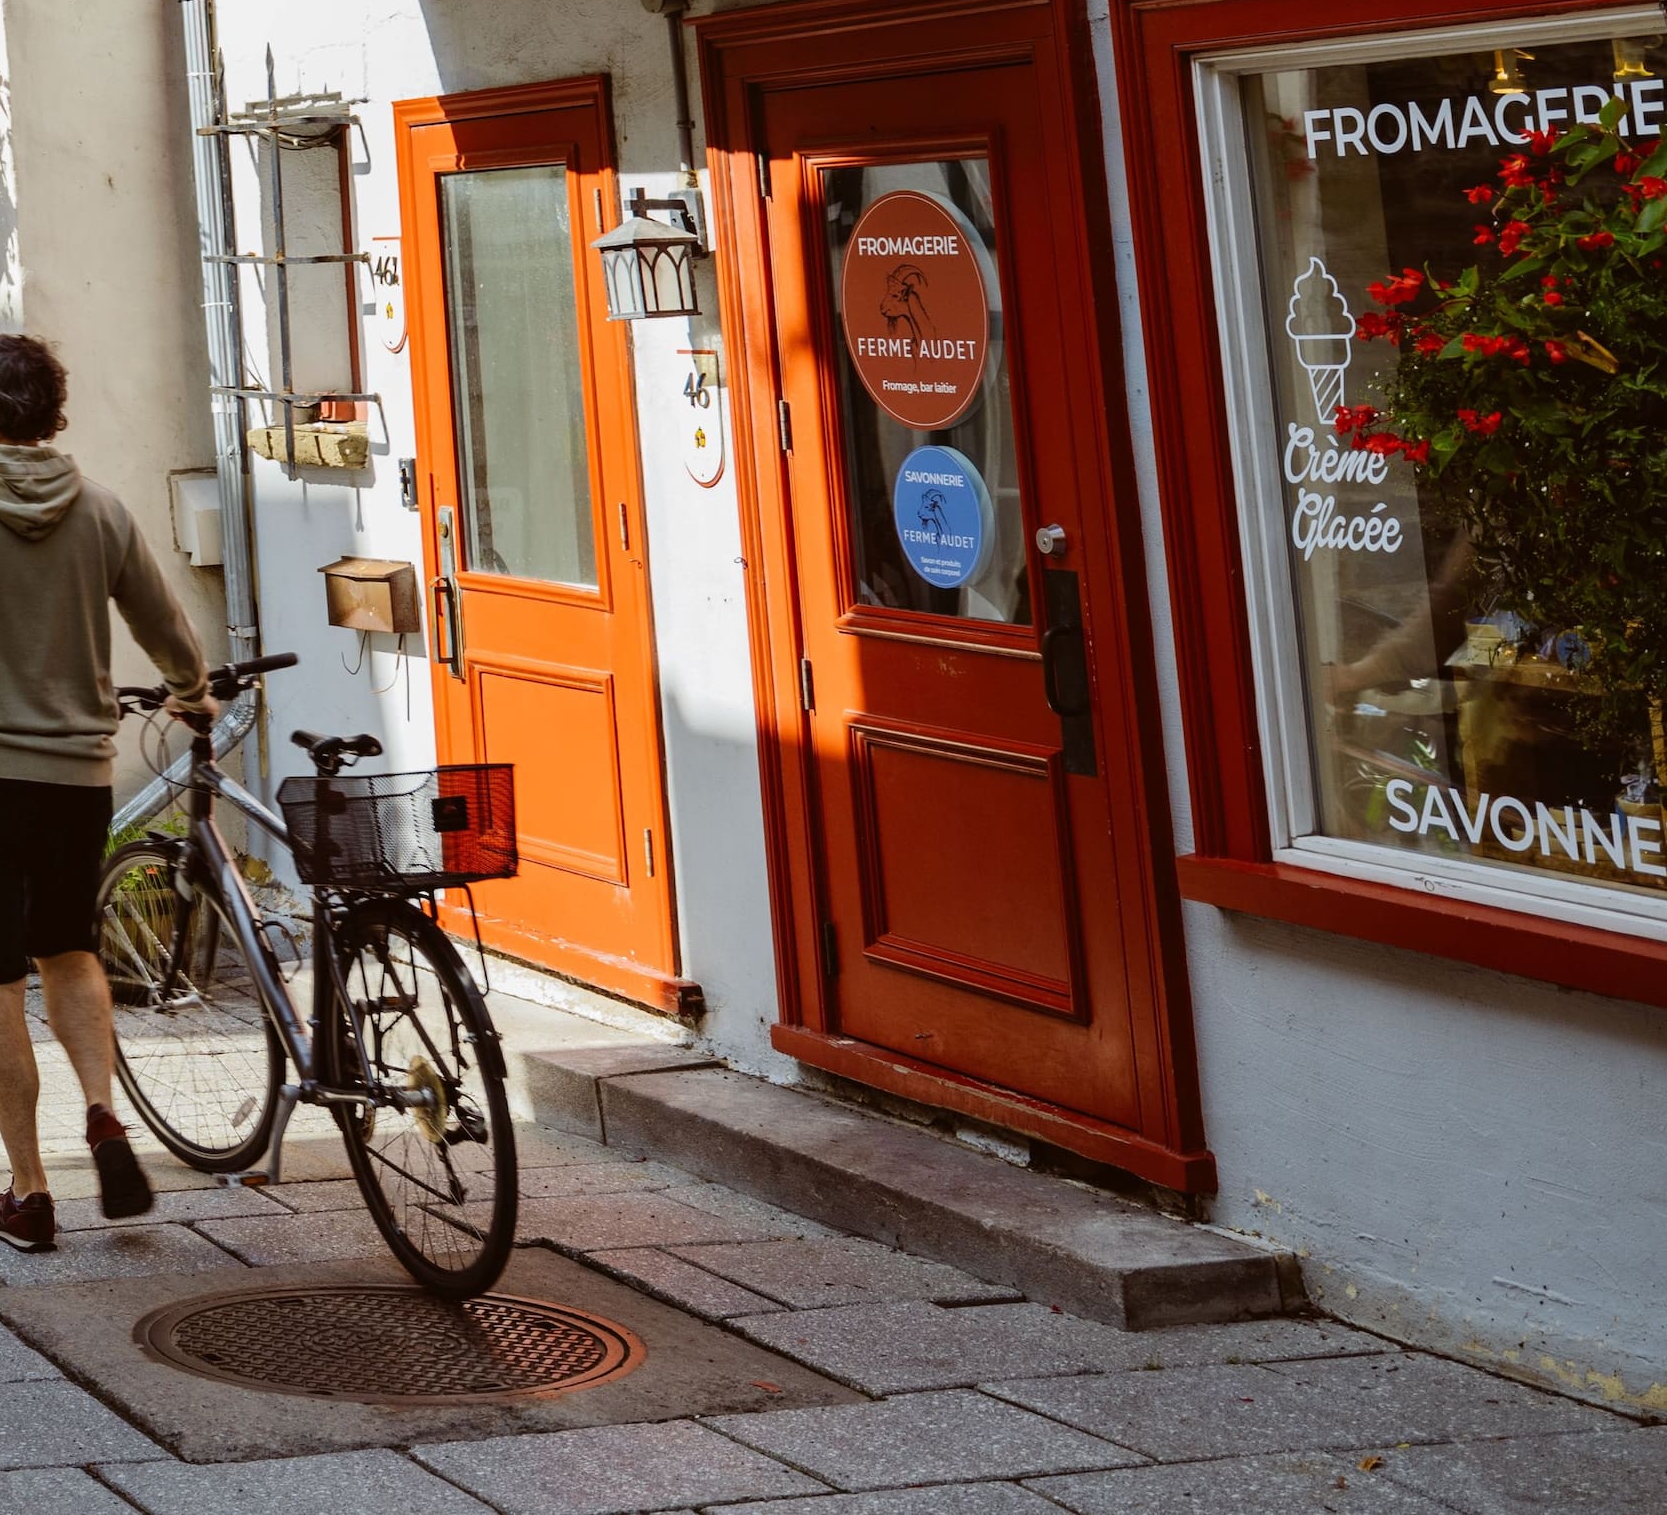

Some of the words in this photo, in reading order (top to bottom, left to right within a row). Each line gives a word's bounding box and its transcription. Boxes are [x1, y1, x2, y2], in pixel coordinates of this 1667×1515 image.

[858, 236, 960, 256] FROMAGERIE
[857, 337, 913, 358] FERME
[919, 339, 977, 360] AUDET
[683, 372, 711, 409] 46
[882, 379, 920, 395] Fromage,
[920, 381, 935, 394] bar
[935, 382, 958, 395] laitier
[1284, 422, 1388, 485] Crème
[905, 470, 964, 487] SAVONNERIE
[1292, 487, 1403, 562] Glacée
[903, 529, 937, 545] FERME
[940, 534, 974, 549] AUDET
[1385, 778, 1667, 878] SAVONNE
